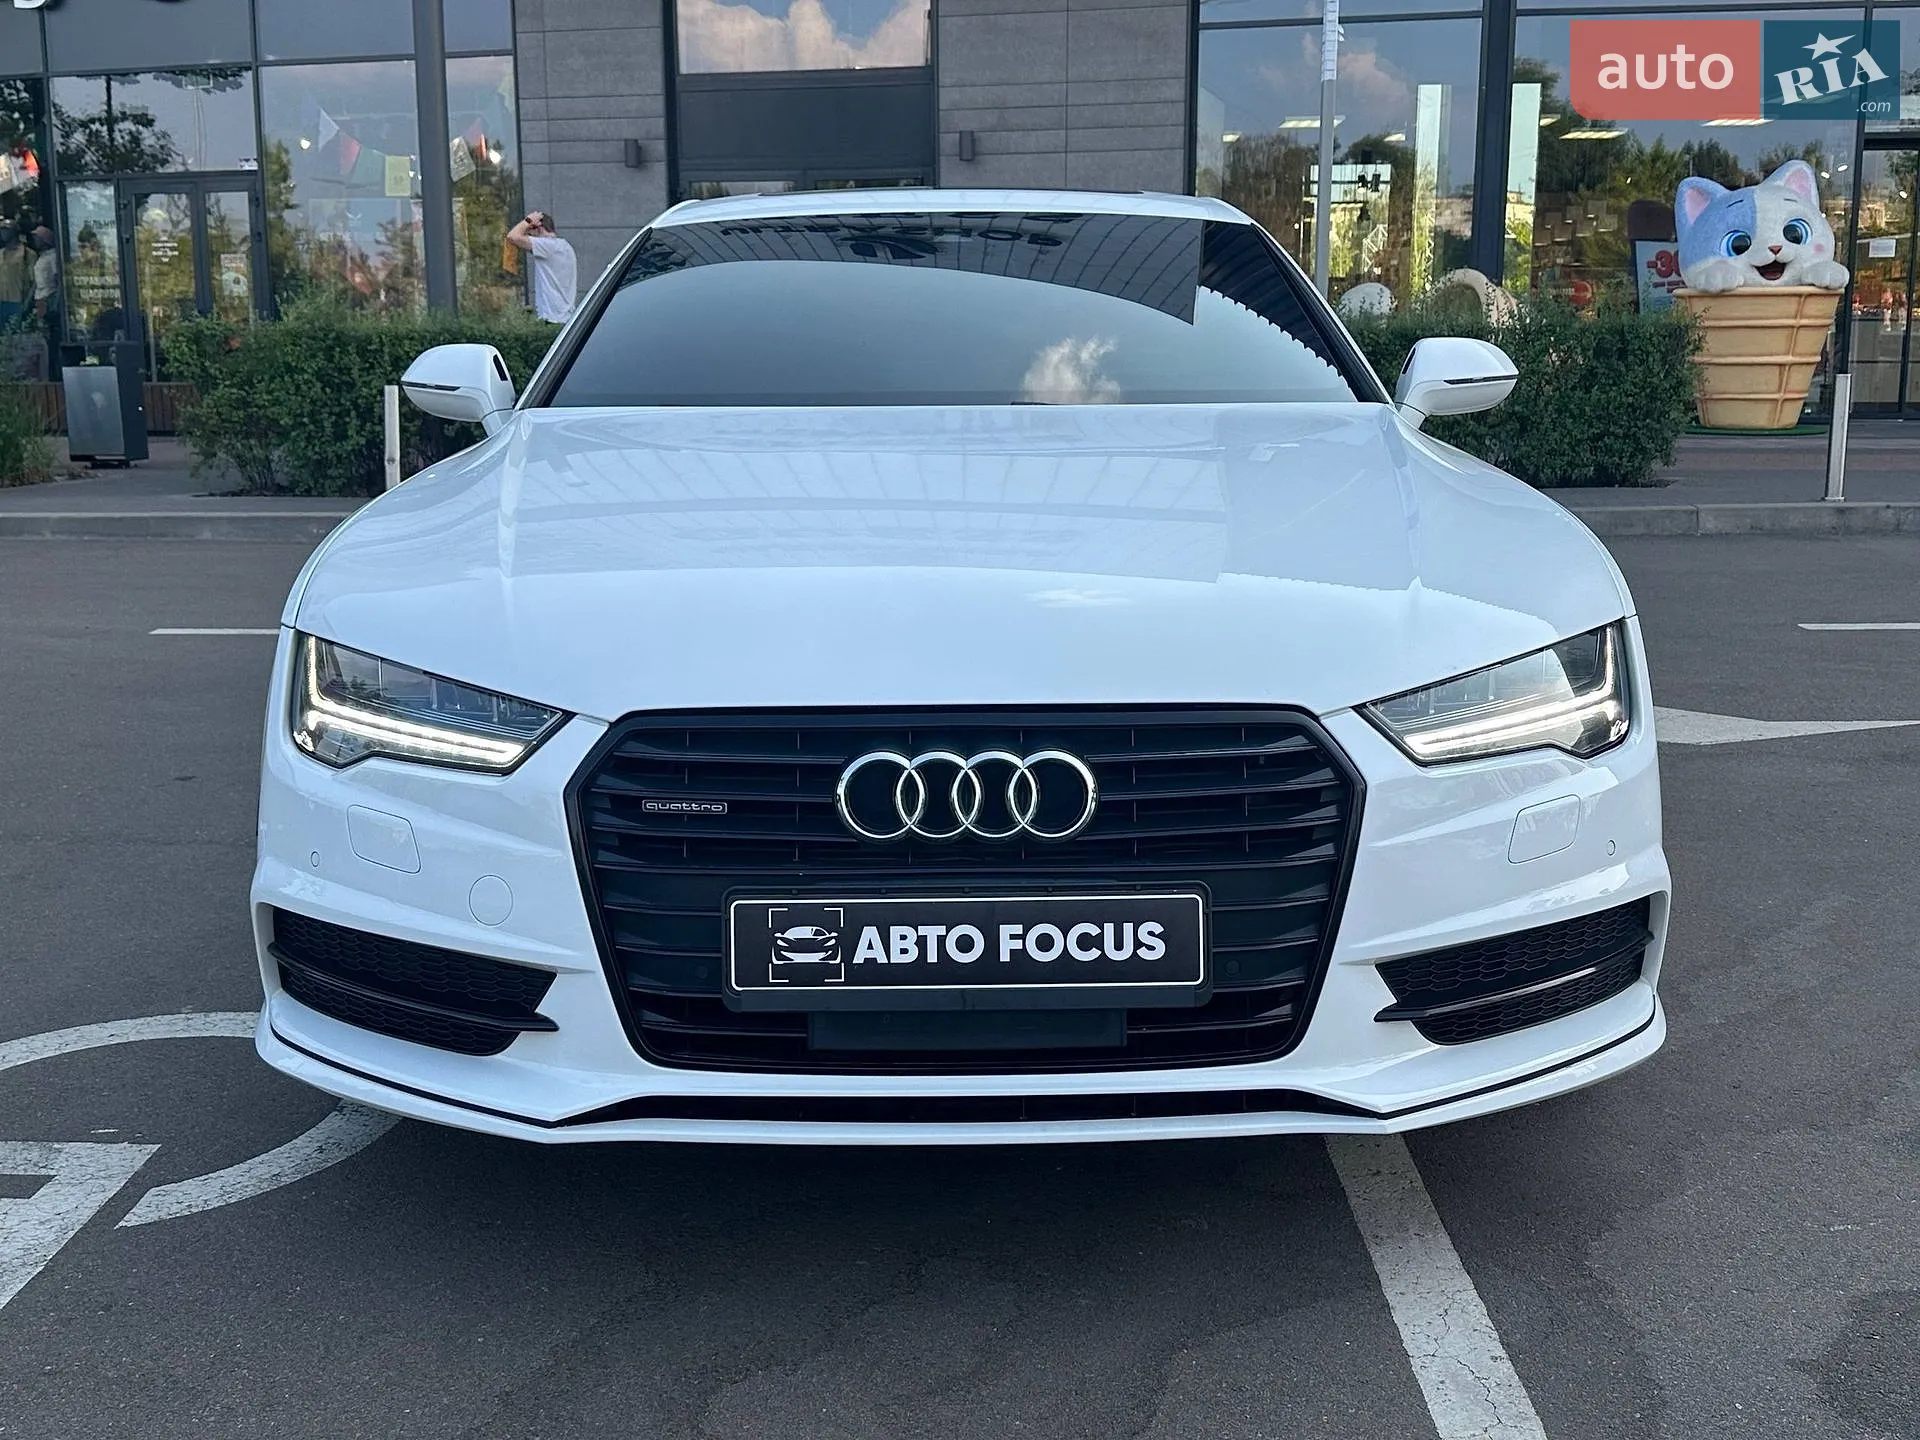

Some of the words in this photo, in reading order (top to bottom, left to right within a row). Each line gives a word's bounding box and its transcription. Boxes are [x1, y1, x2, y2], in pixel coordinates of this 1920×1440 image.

[1647, 250, 1681, 278] -3
[646, 802, 723, 812] quattro
[999, 921, 1166, 963] FOCUS
